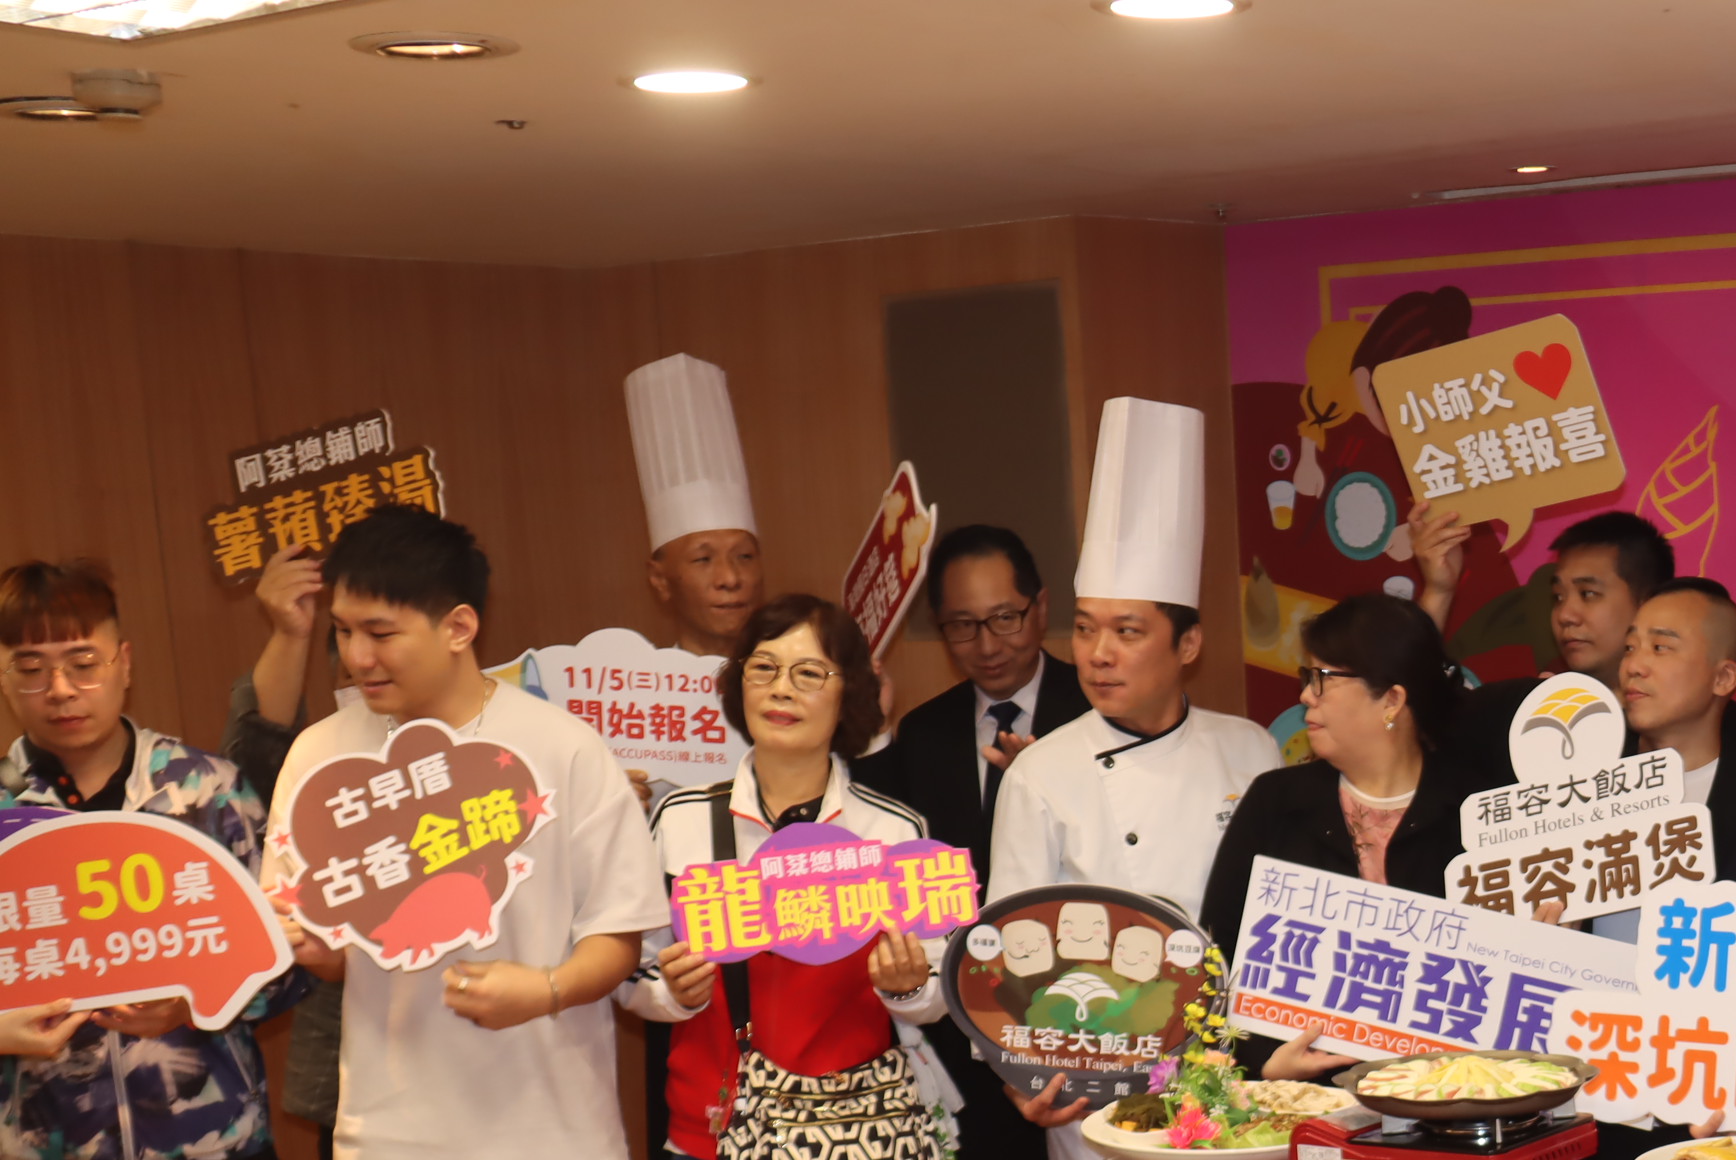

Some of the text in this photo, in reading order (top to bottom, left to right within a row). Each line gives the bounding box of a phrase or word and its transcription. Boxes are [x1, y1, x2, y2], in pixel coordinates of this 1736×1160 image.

[1400, 369, 1513, 434] 小師父
[1413, 405, 1606, 499] 金雞報喜
[567, 700, 726, 744] 開始報名
[325, 752, 452, 829] 古早厝
[1477, 756, 1667, 827] 福容大飯店
[1478, 794, 1670, 848] Fullon Hotels & Resorts
[312, 788, 522, 908] 古香金蹄
[1457, 815, 1705, 915] 福容滿煲
[76, 853, 165, 921] 50
[172, 861, 215, 906] 桌
[676, 851, 975, 953] 龍鱗映瑞
[1258, 867, 1469, 952] 新北市政府
[1238, 914, 1582, 1055] 經濟發展
[1466, 942, 1500, 959] New
[1503, 950, 1545, 971] Taipei
[1548, 961, 1577, 980] City
[1000, 1025, 1162, 1058] 福容大飯店
[1239, 996, 1348, 1039] Economic
[1001, 1051, 1043, 1066] Fullon
[1045, 1054, 1080, 1069] Hotel
[1081, 1057, 1127, 1074] Taipei,
